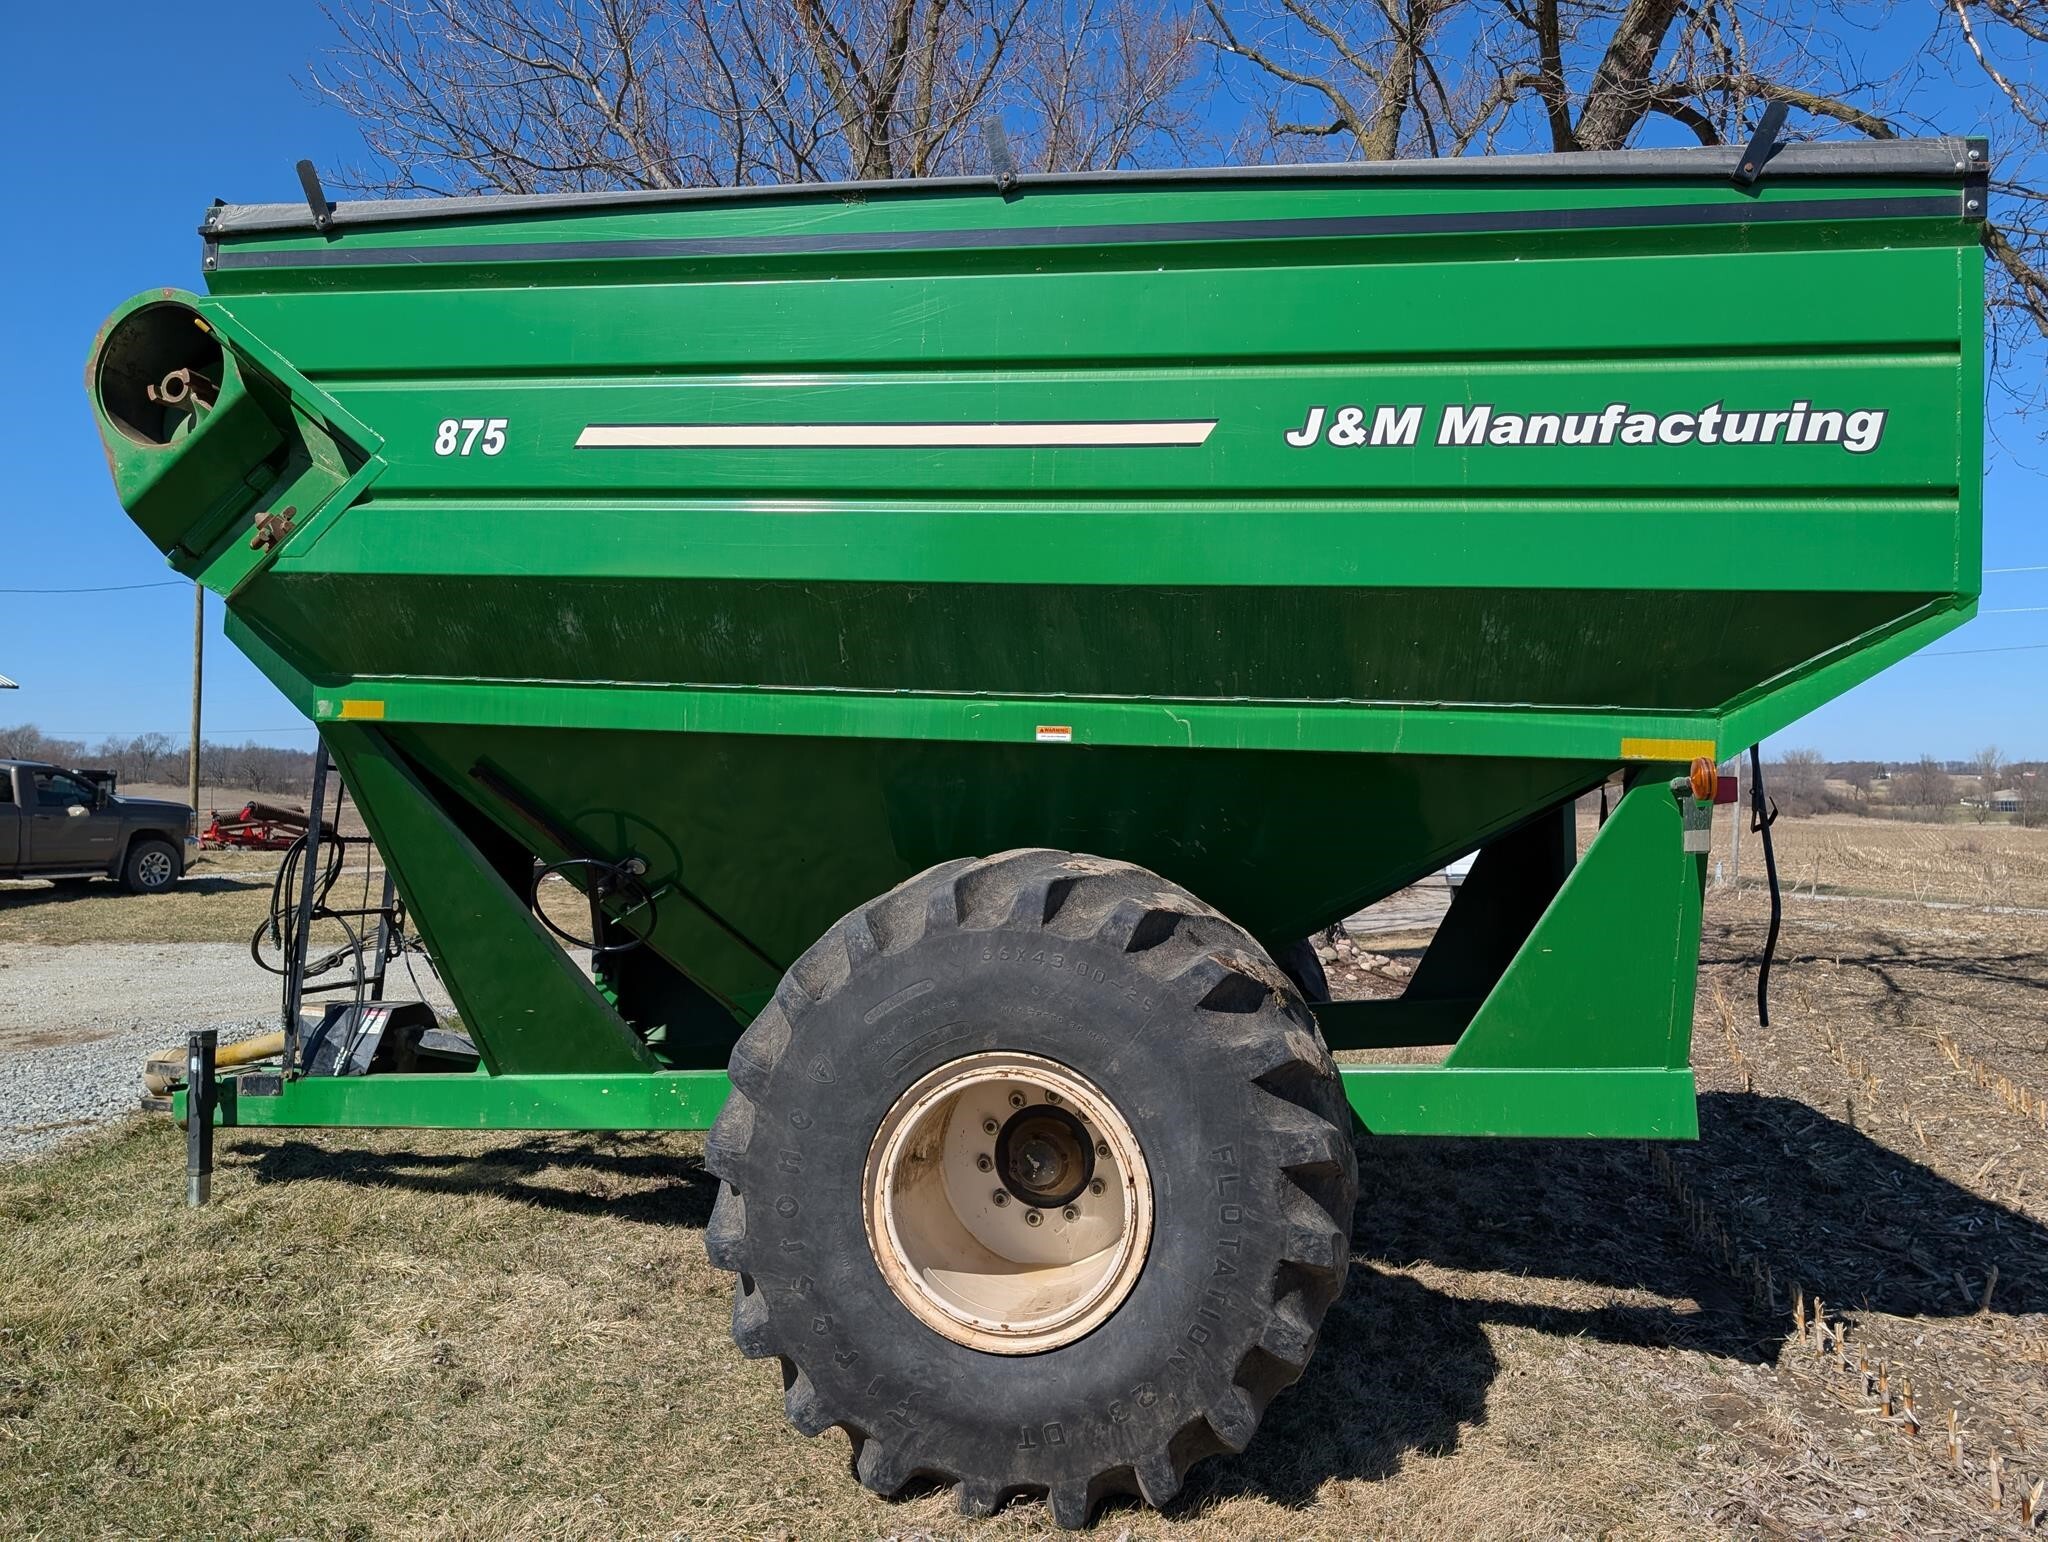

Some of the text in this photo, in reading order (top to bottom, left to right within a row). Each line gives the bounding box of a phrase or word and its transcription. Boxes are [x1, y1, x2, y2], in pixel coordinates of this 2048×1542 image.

[434, 418, 508, 456] 875
[1285, 400, 1889, 454] J&M Manufacturing
[776, 1108, 922, 1429] Firestone
[1167, 1144, 1243, 1375] FLOTATION
[1017, 1421, 1066, 1449] DT
